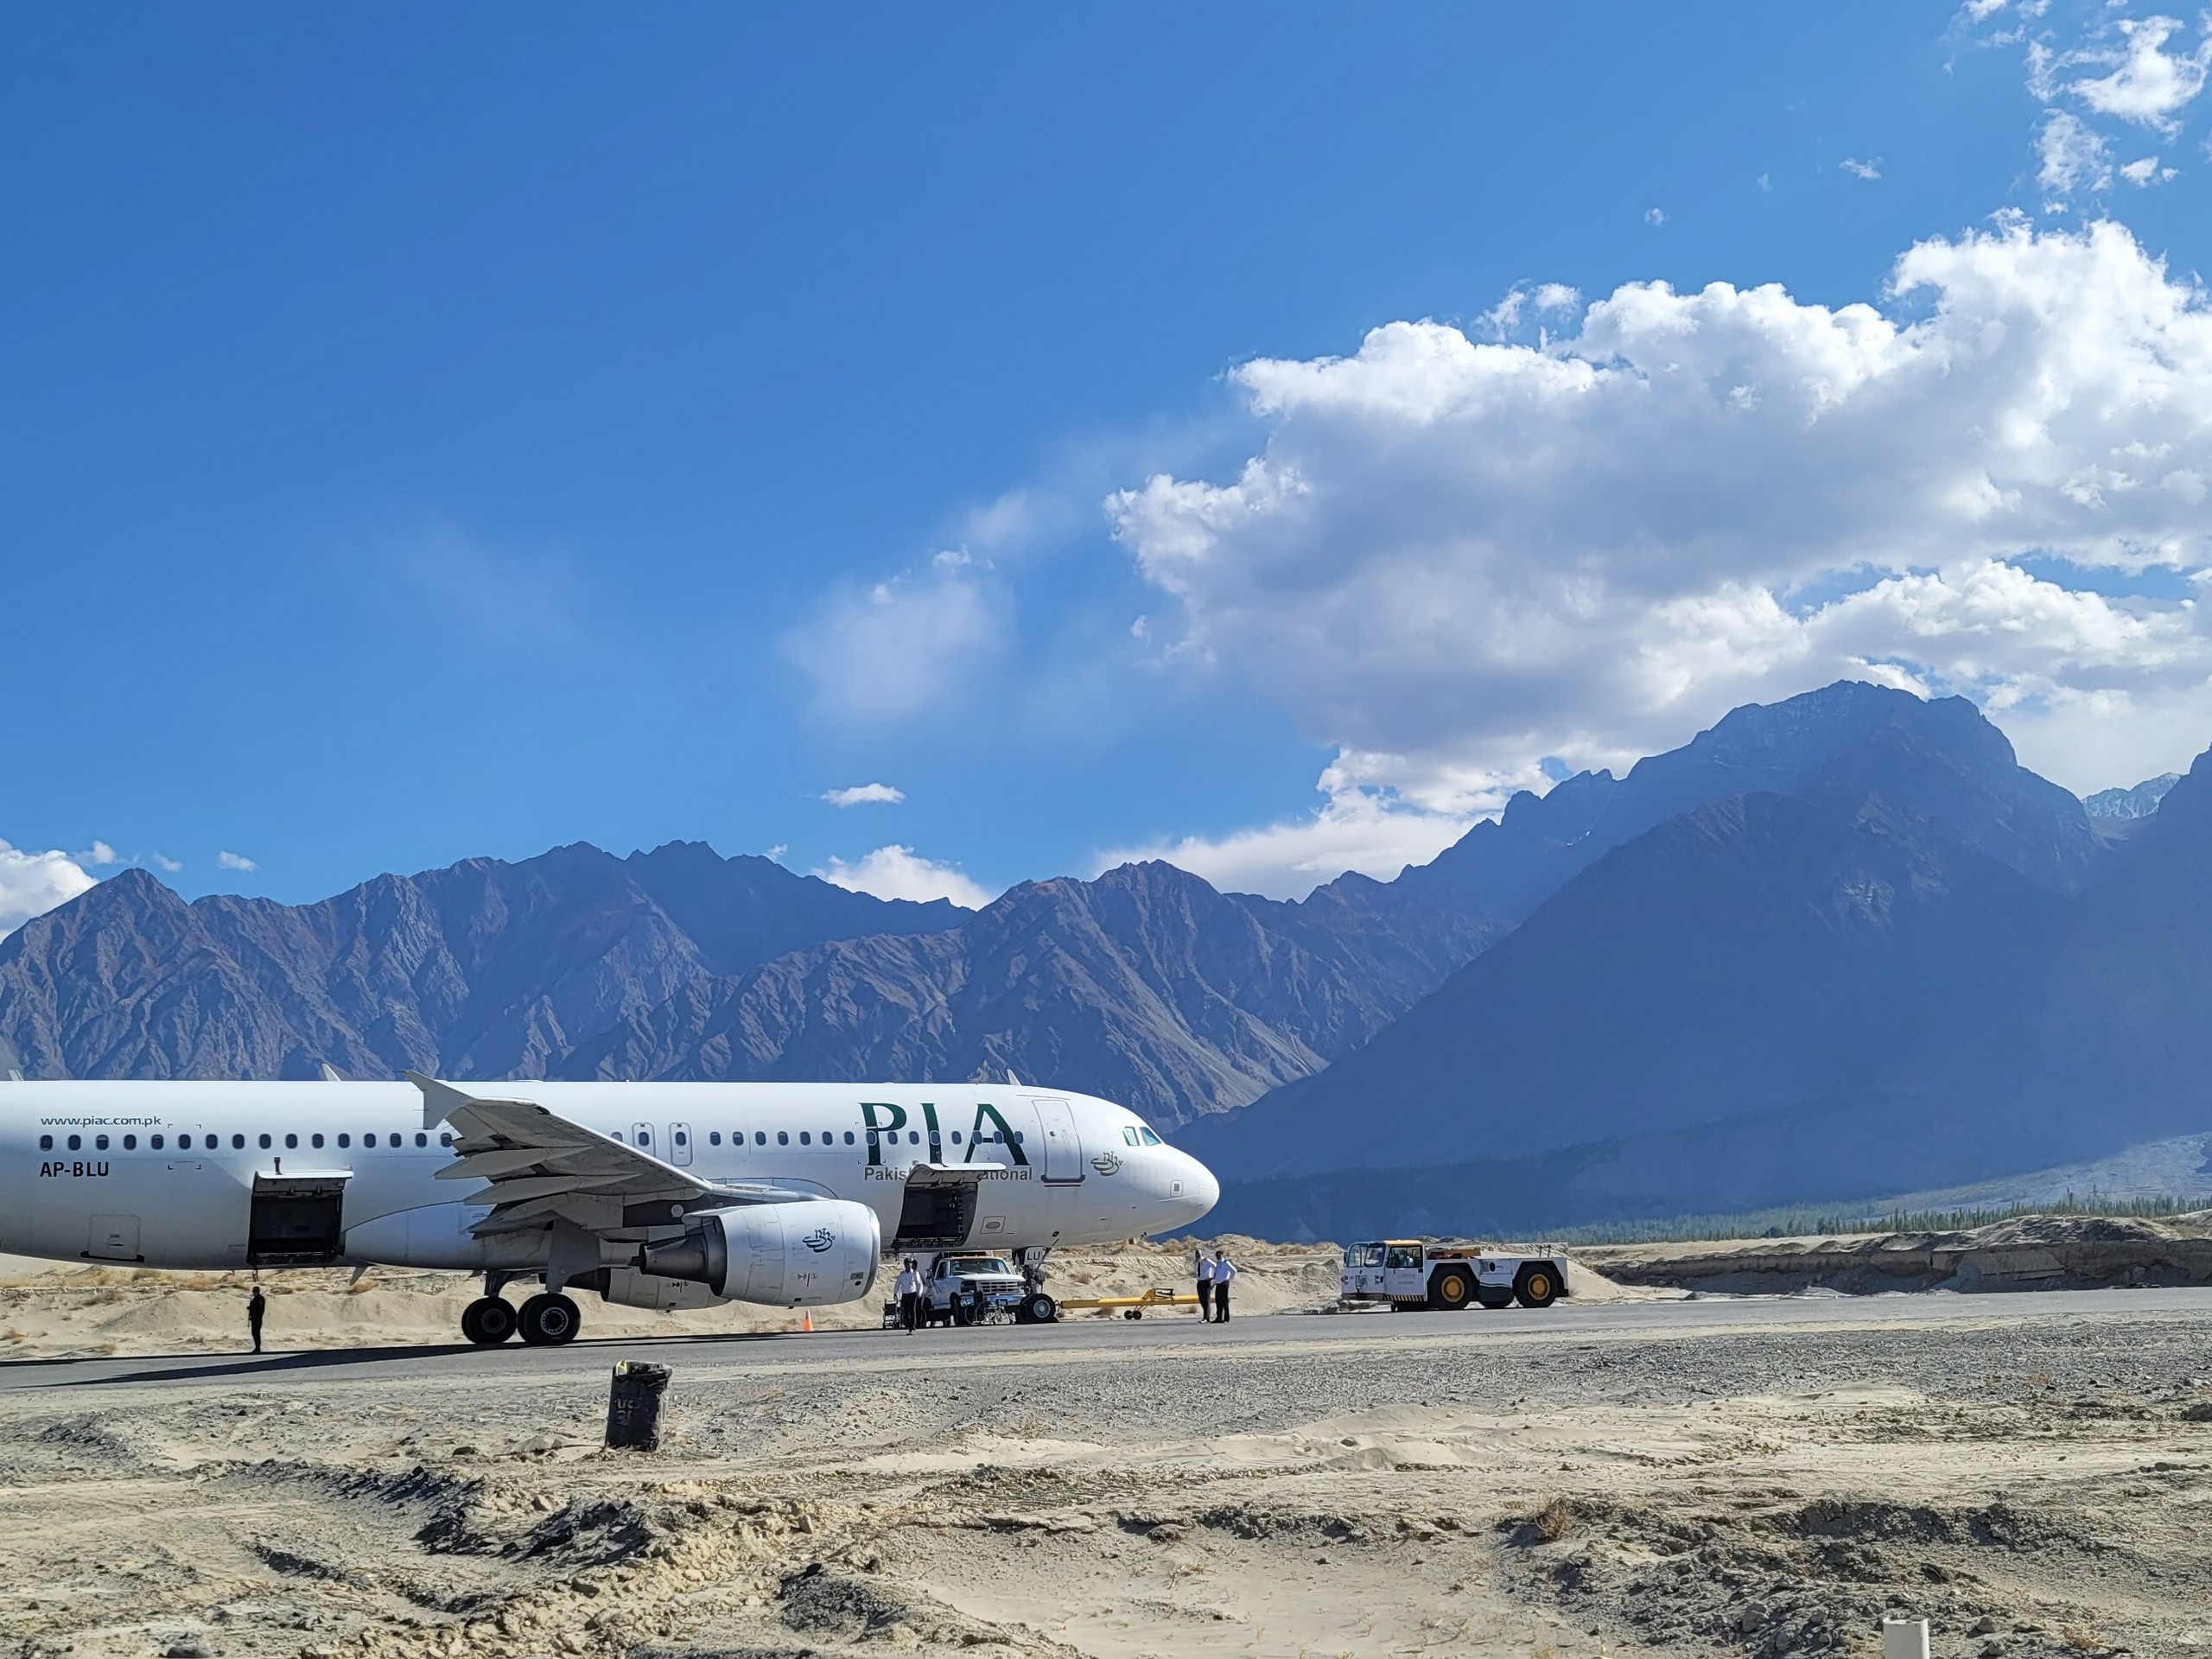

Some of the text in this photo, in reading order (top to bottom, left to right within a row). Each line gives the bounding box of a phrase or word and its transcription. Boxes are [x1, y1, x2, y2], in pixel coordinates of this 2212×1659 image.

[41, 1116, 162, 1128] www.piac.com.pk
[859, 1103, 1032, 1166] PIA
[40, 1161, 109, 1177] AP-BLU
[864, 1166, 911, 1180] Pakis
[1027, 1251, 1041, 1261] LU
